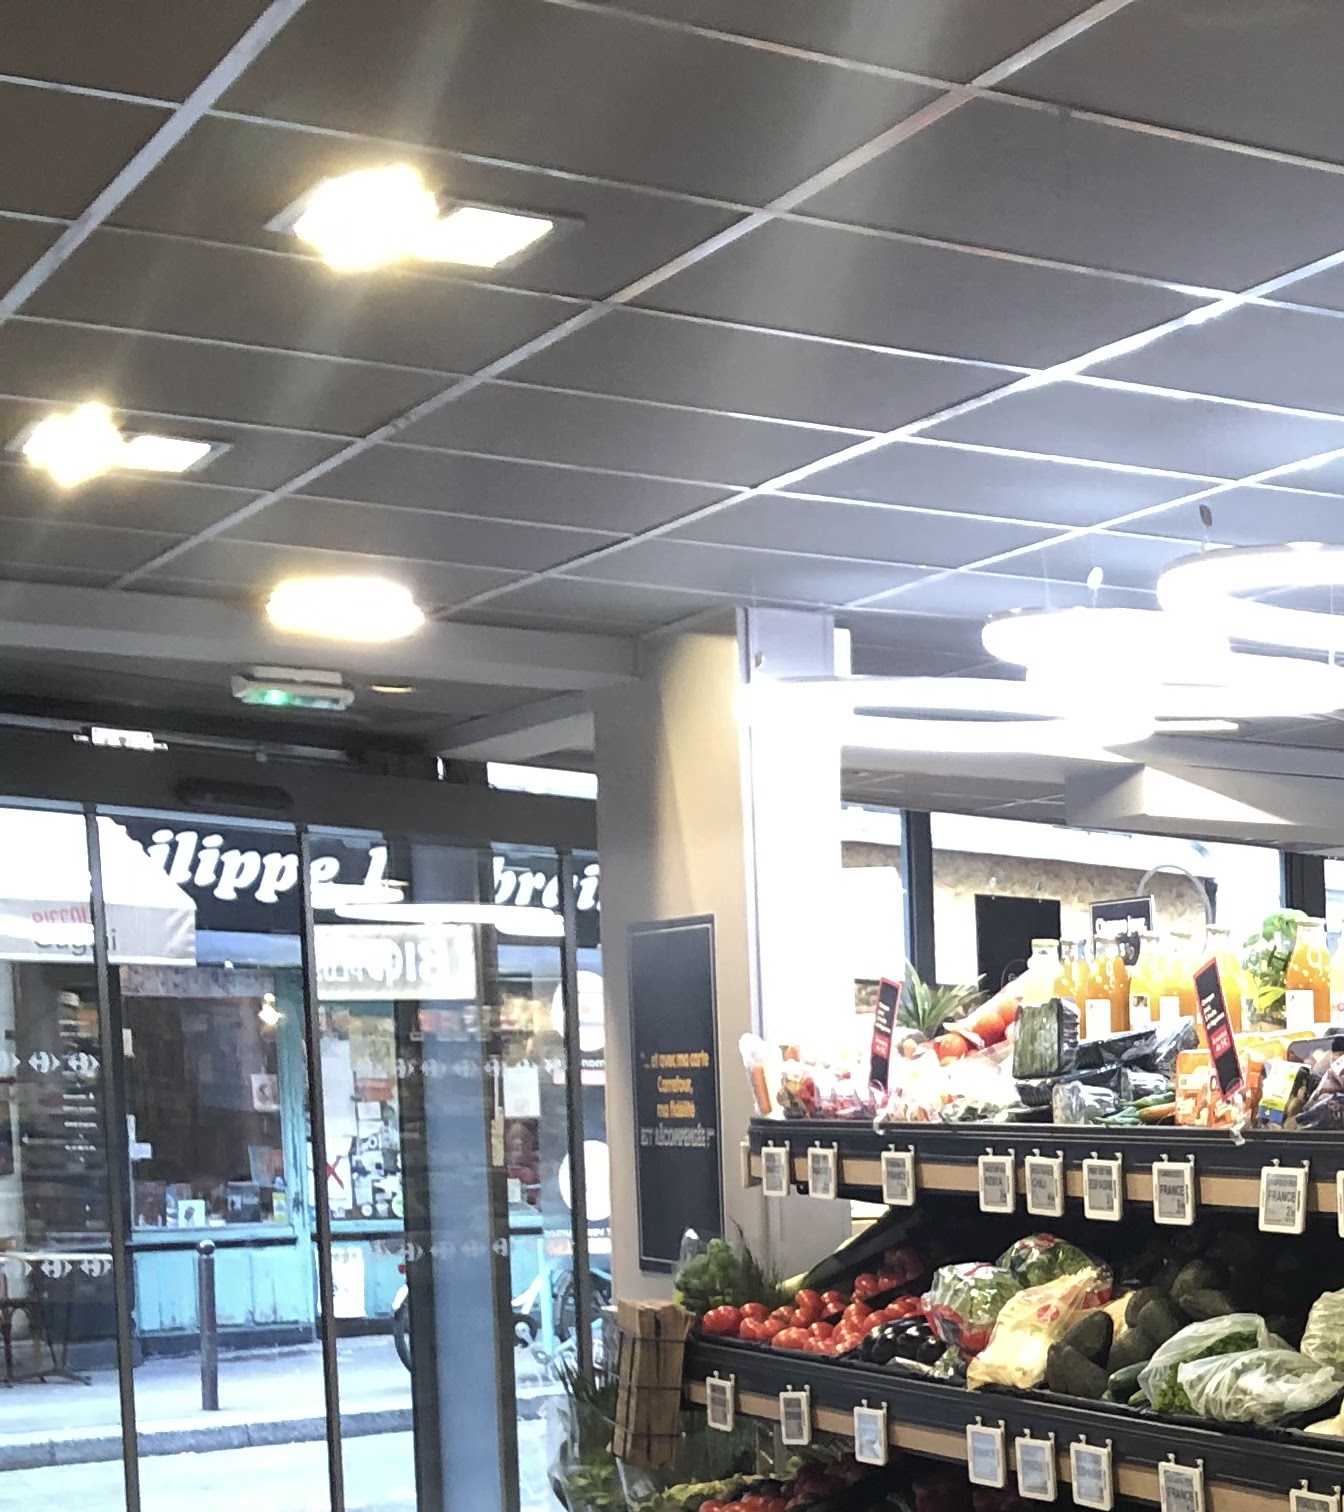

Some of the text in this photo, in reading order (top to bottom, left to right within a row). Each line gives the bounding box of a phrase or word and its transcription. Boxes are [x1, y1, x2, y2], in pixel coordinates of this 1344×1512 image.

[147, 829, 341, 903] ilippe
[1160, 1184, 1184, 1197] FRANCE
[1268, 1190, 1296, 1203] FRANCE
